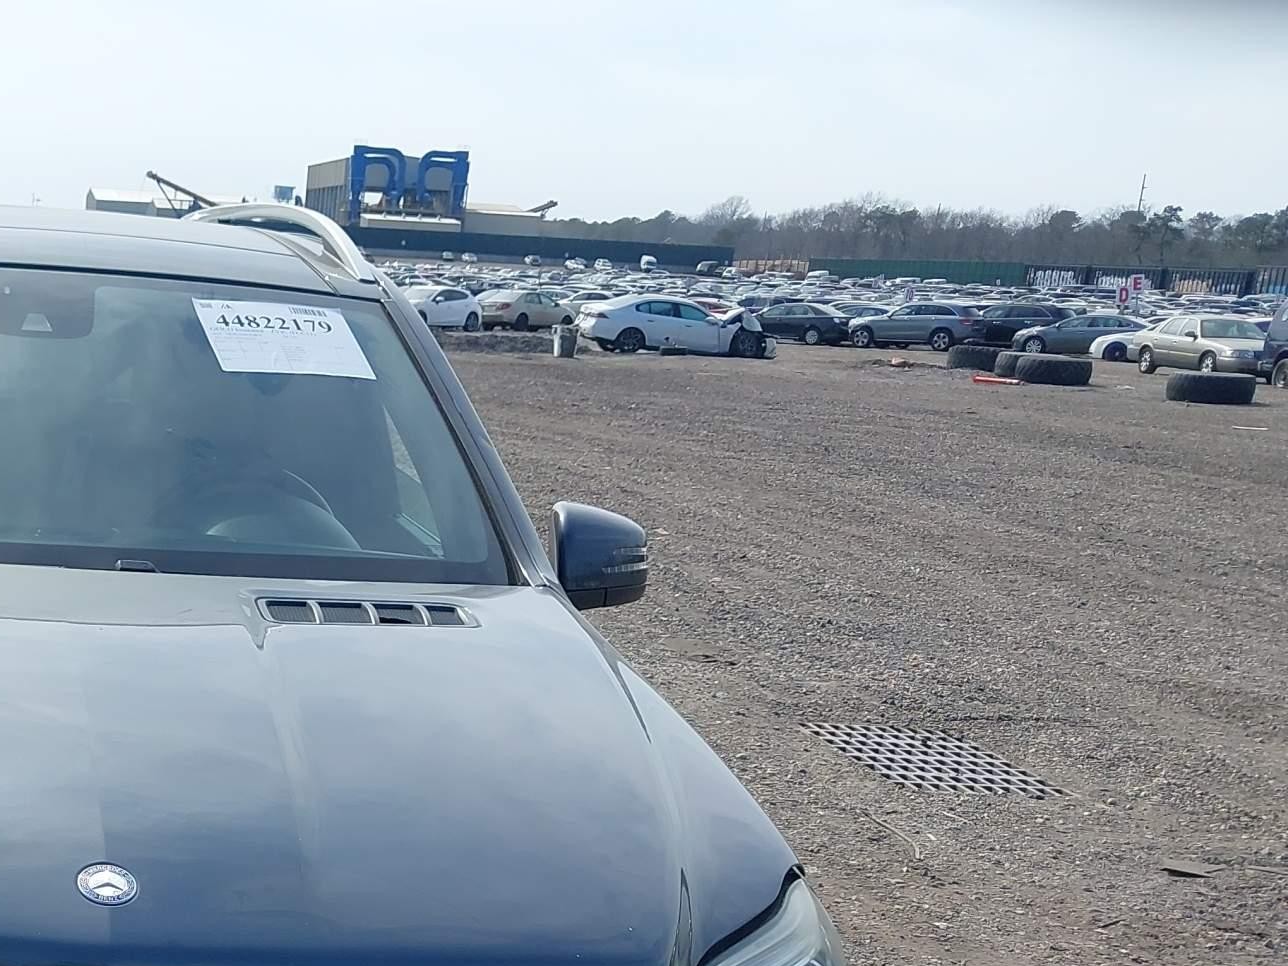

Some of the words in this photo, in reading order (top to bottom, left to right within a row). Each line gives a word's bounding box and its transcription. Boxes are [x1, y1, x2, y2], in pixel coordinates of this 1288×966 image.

[1133, 276, 1143, 291] E
[1119, 287, 1129, 304] D
[215, 313, 333, 334] 44822179
